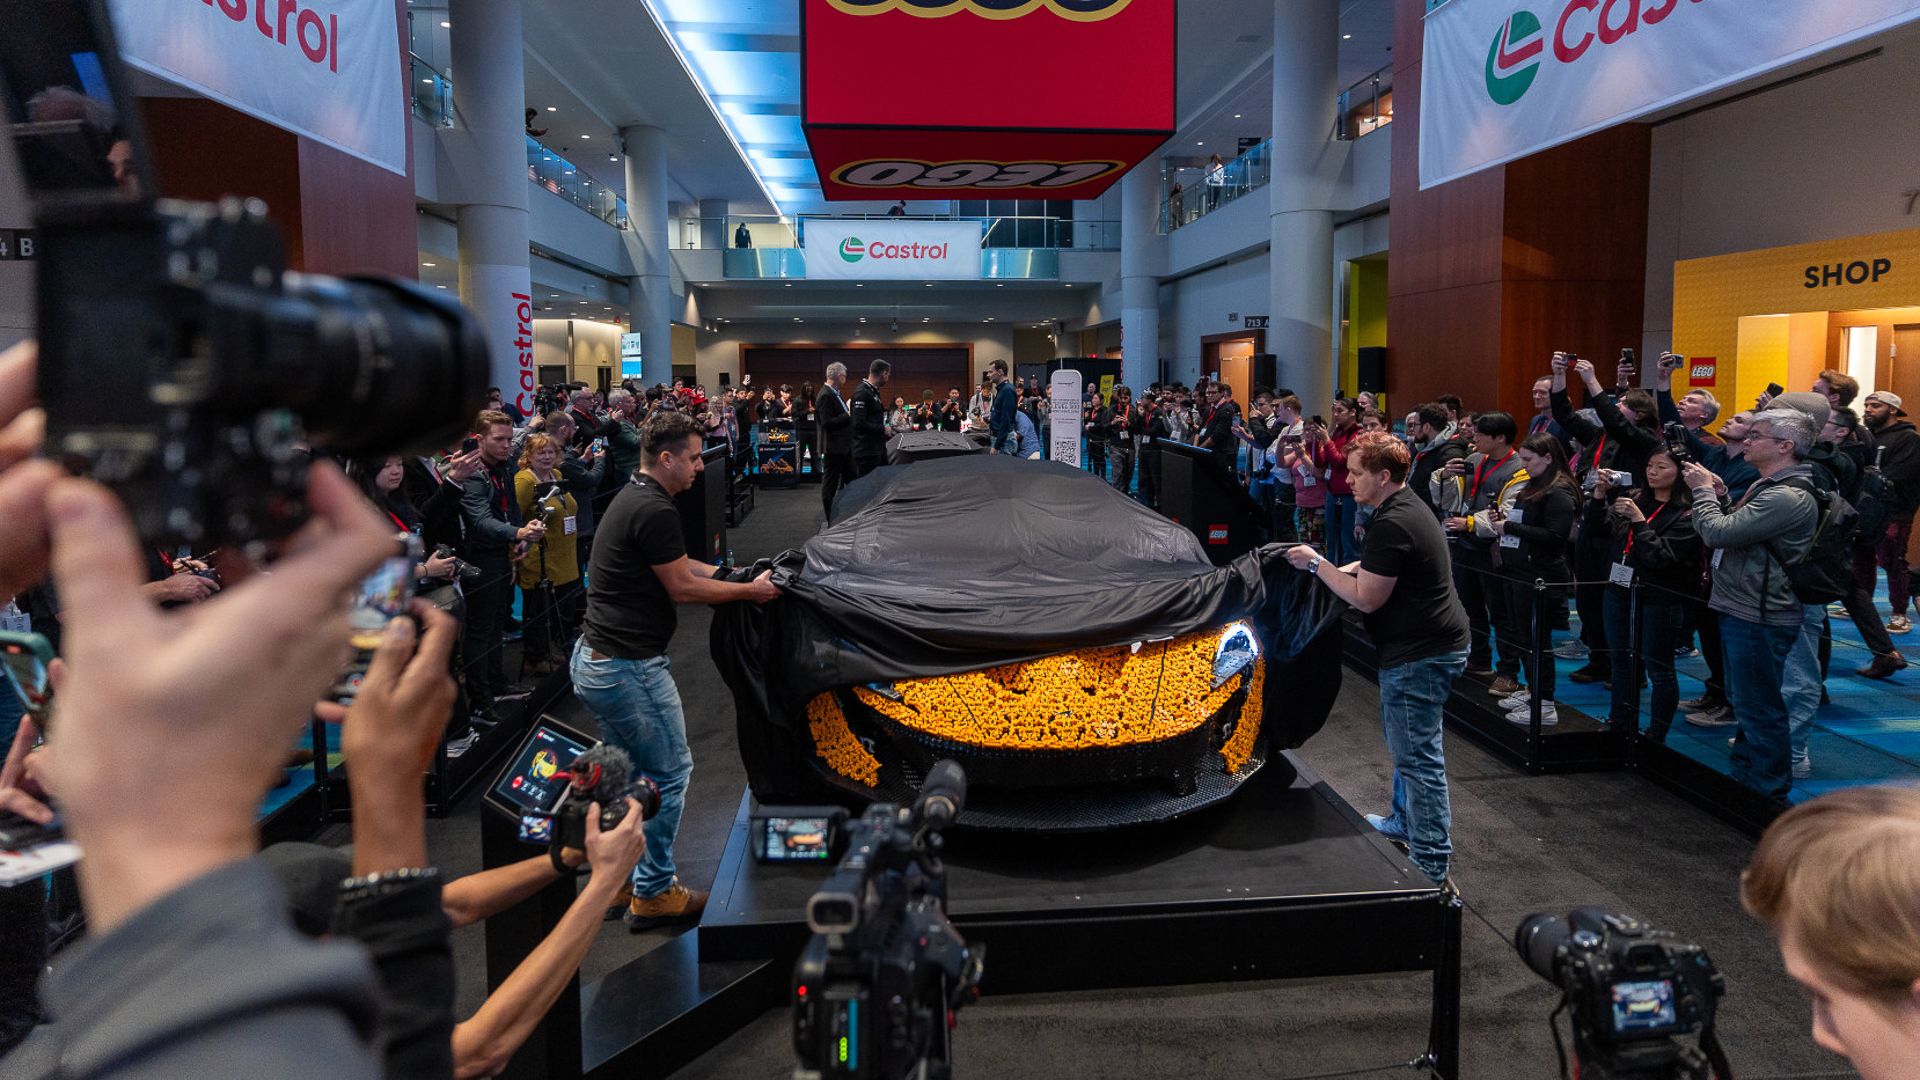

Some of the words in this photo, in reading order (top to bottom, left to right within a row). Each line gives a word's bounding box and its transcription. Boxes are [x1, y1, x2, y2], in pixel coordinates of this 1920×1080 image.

[846, 161, 1113, 186] LEGO
[19, 237, 34, 257] B
[869, 241, 948, 259] Castrol
[1804, 258, 1891, 288] SHOP
[1247, 318, 1261, 327] 713
[512, 292, 534, 417] Castrol
[1692, 366, 1714, 378] LEGO
[1210, 529, 1228, 539] LEGO
